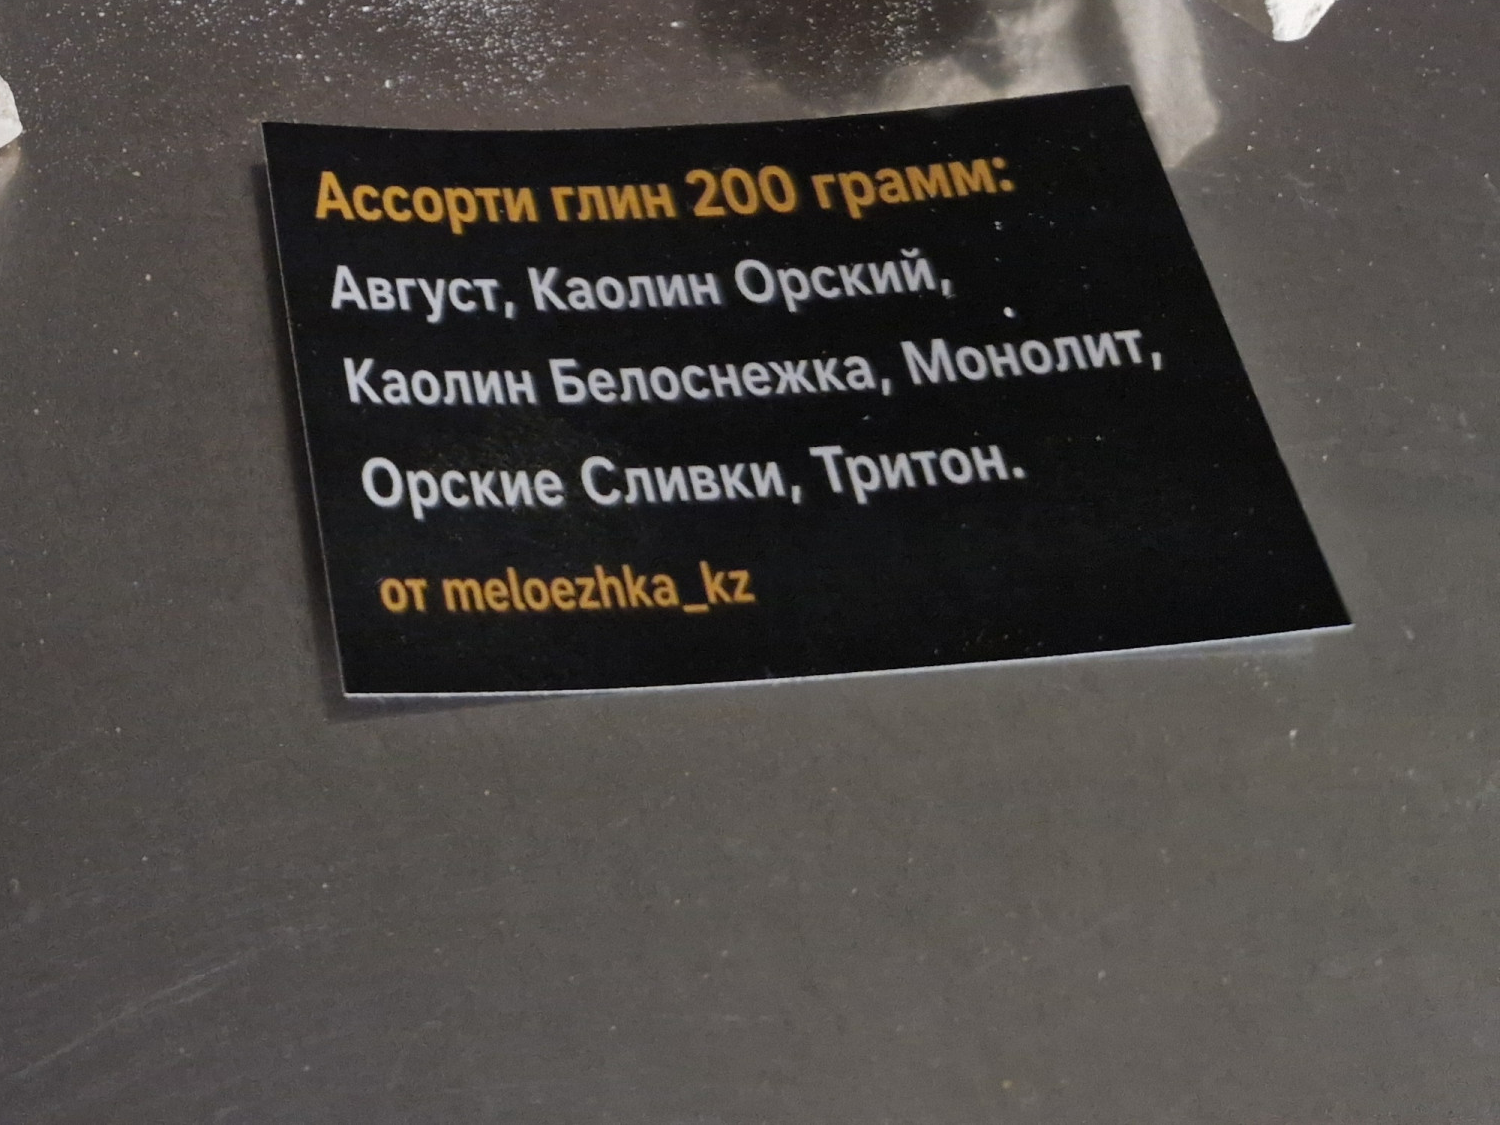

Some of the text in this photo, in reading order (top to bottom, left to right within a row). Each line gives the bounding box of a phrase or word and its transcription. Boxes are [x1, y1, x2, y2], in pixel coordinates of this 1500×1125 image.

[315, 157, 1014, 235] Ассорти глин 200 грамм:
[330, 247, 953, 324] Август, Каолин Орский,
[343, 324, 1162, 406] Каолин Белоснежка, Монолит,
[361, 444, 1025, 521] Орские Сливки, Тритон.
[379, 560, 756, 613] от meloezhka_kz
